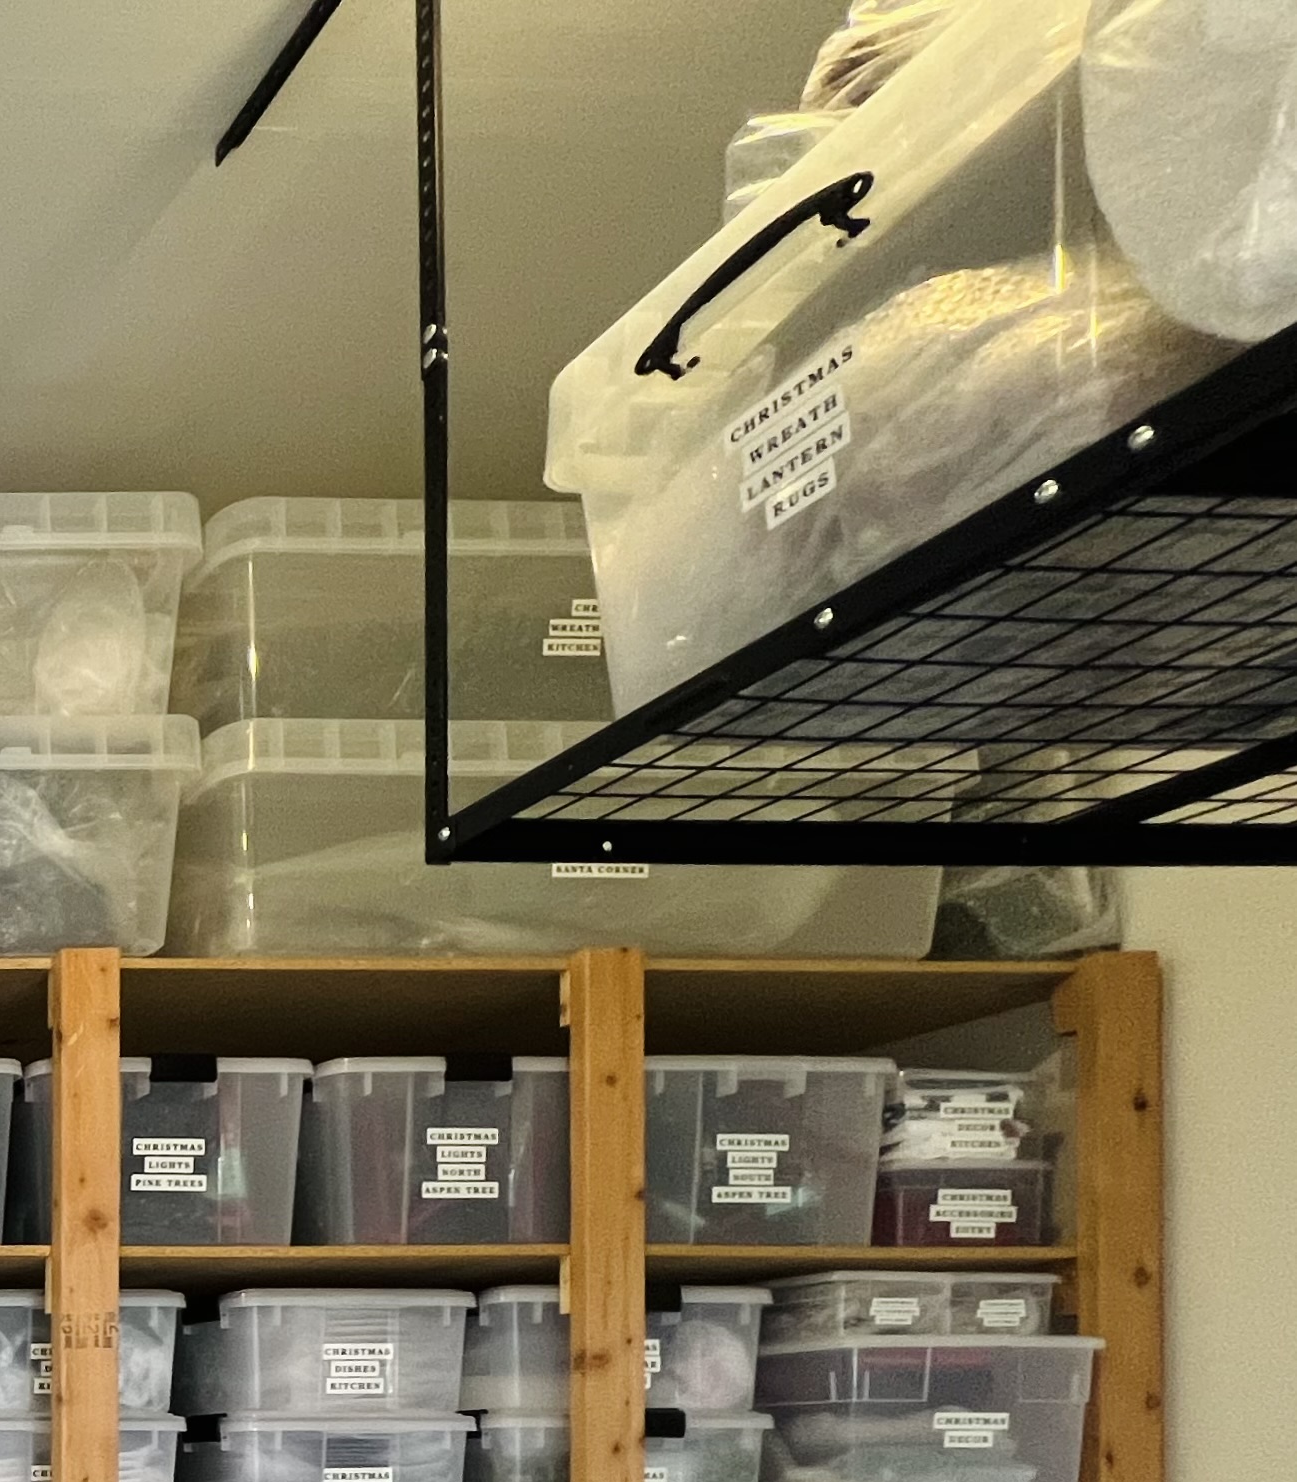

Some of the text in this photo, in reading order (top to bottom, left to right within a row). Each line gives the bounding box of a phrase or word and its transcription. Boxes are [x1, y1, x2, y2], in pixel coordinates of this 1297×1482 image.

[730, 345, 853, 443] CHRISTMAS
[749, 394, 838, 464] WREATH
[746, 424, 844, 501] LANTERN
[773, 472, 830, 518] RUGS
[556, 865, 593, 874] SANTA
[429, 1132, 497, 1141] CHRISTMAS
[135, 1143, 204, 1151] CHRISTMAS
[440, 1150, 483, 1159] LIGHTS
[148, 1161, 191, 1169] LIGHTS
[441, 1168, 482, 1177] NORTH
[135, 1179, 204, 1188] PINE TREES
[424, 1186, 495, 1195] ASPEN TREE
[324, 1348, 390, 1356] CHRISTMAS
[334, 1365, 377, 1373] DISHES
[330, 1382, 381, 1390] KITCHEN
[324, 1471, 391, 1481] CHRISTMAS
